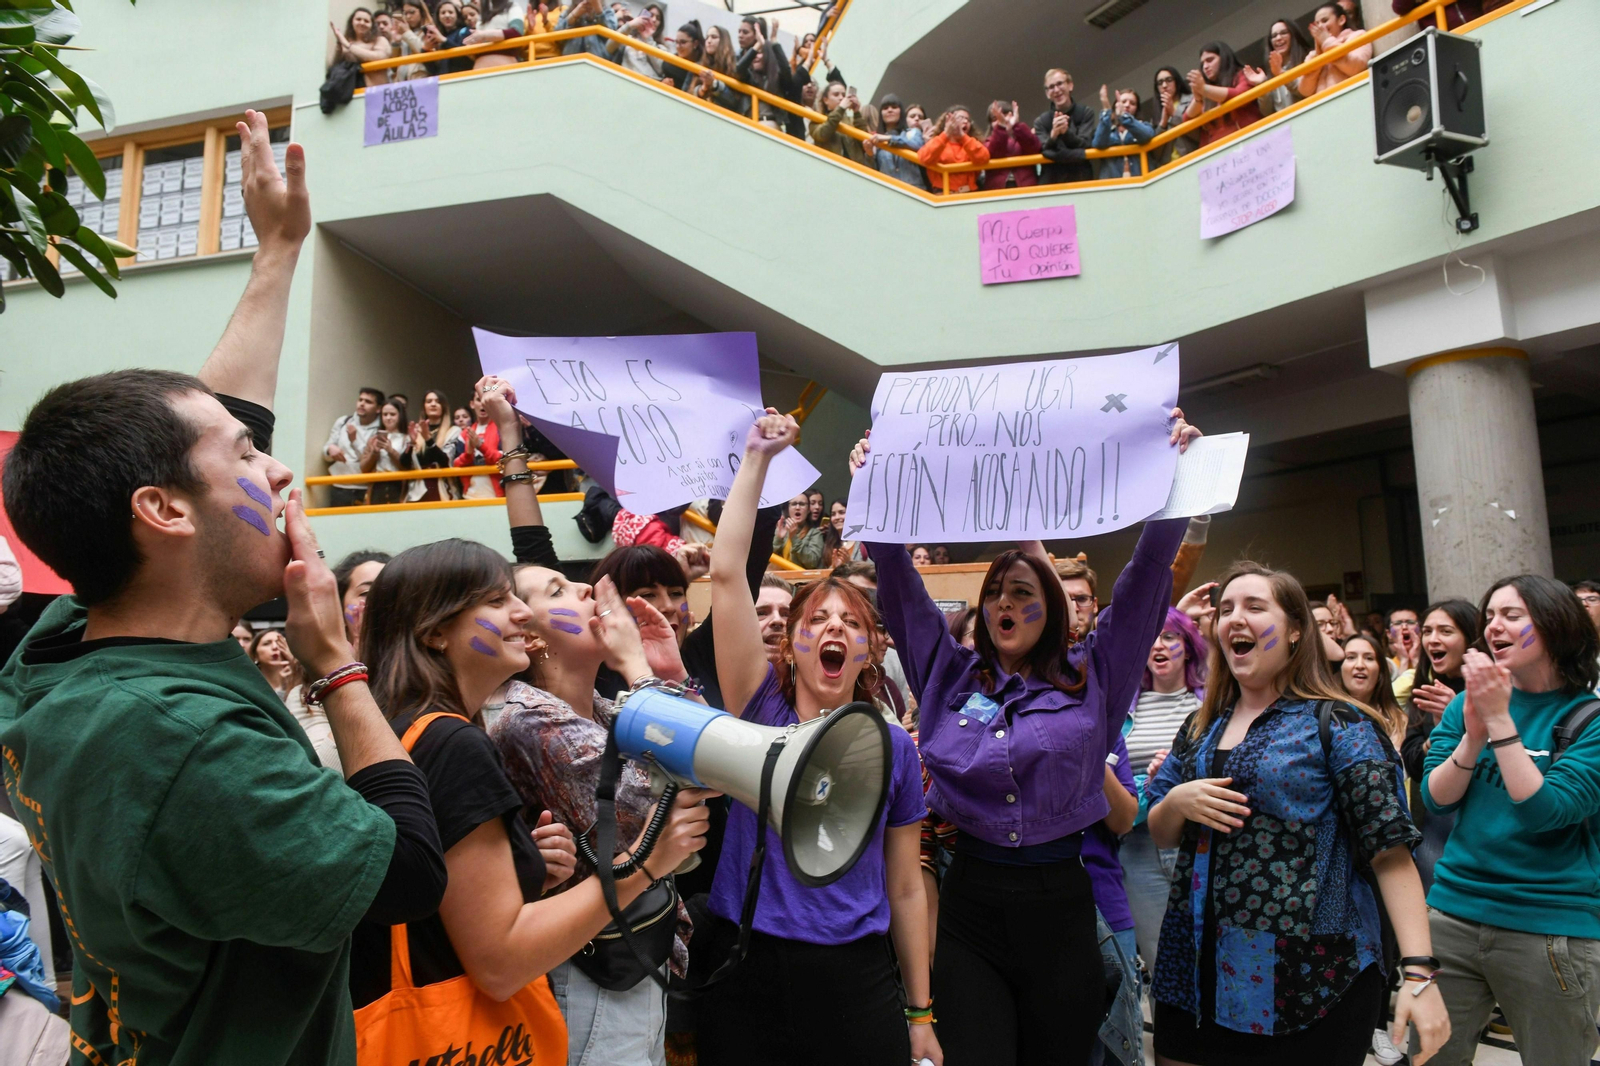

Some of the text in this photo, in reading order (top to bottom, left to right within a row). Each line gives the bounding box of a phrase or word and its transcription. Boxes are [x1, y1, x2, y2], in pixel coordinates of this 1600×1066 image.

[383, 84, 415, 101] FUERA
[377, 106, 428, 128] DE LAS
[382, 97, 417, 115] ACOSO
[381, 120, 428, 143] AULAS
[1231, 199, 1278, 228] STOP ACOSO
[1017, 216, 1063, 241] Cuerpo
[997, 242, 1075, 263] NO QUIERE
[526, 359, 682, 405] ESTO ES
[881, 364, 1078, 416] PERDONA UGR
[925, 410, 1046, 447] PERO... NOS
[667, 458, 724, 478] A ver si con
[680, 470, 718, 488] dibujitos
[864, 441, 950, 536] ESTÁN
